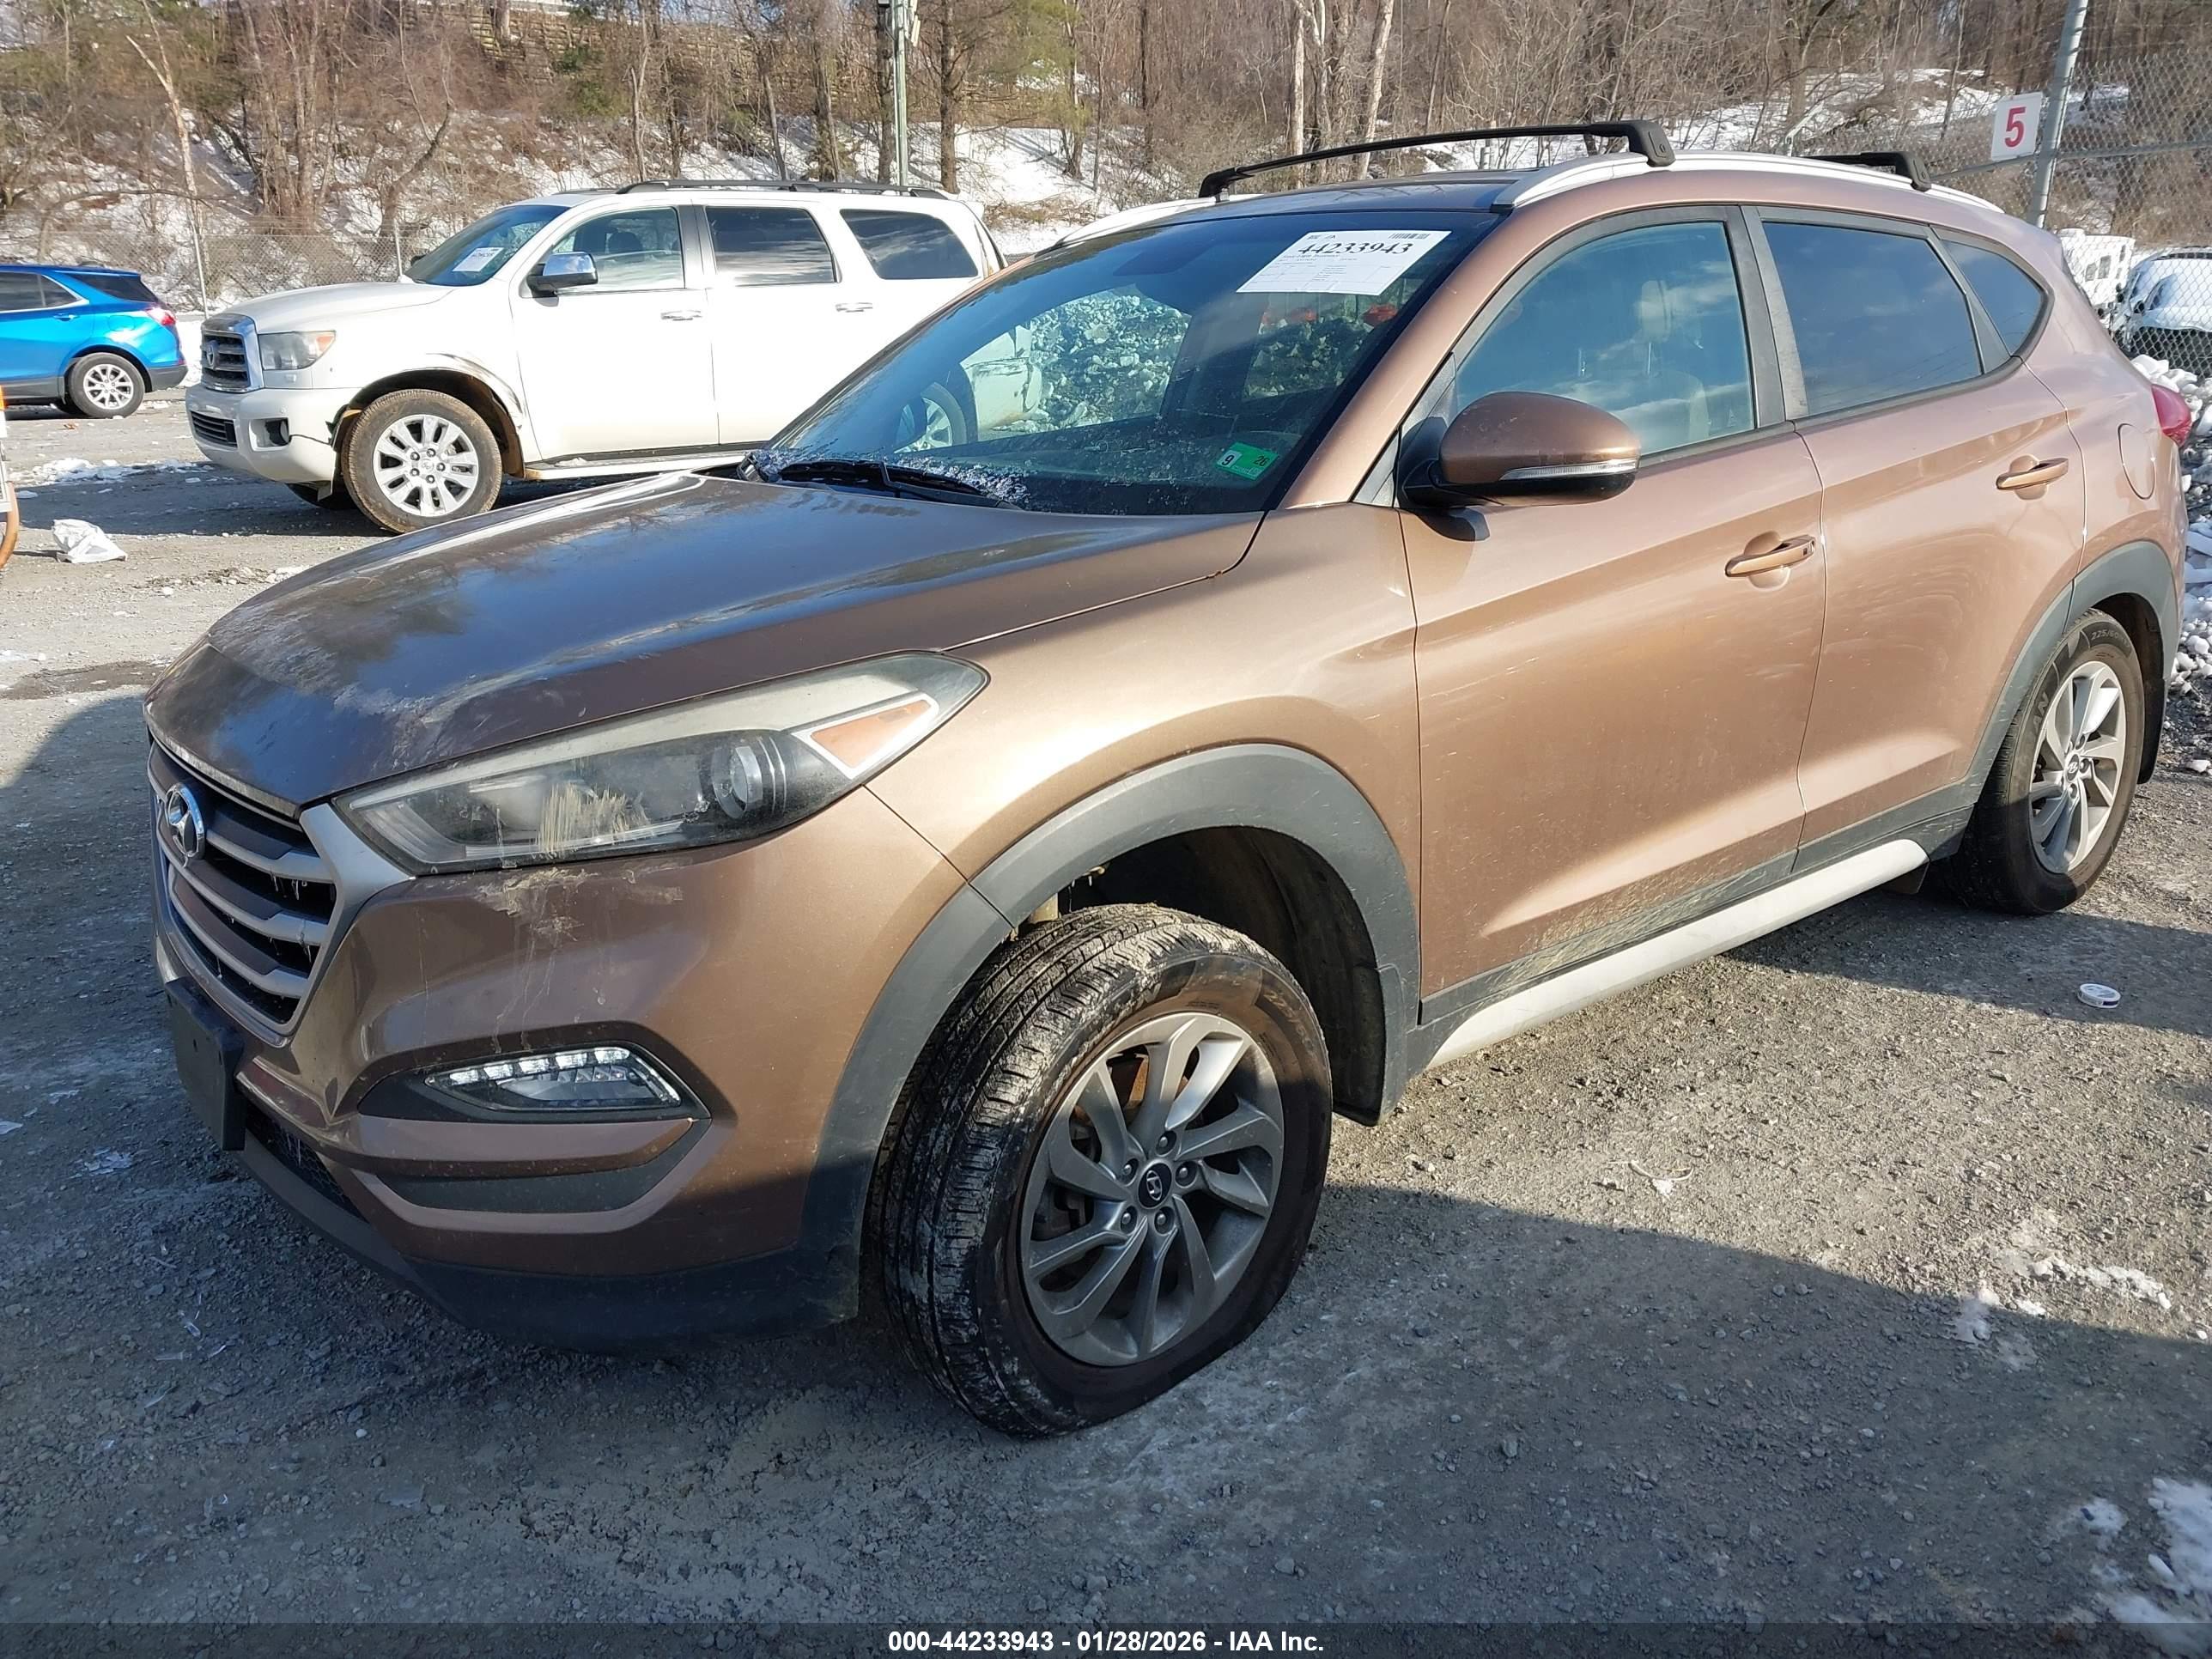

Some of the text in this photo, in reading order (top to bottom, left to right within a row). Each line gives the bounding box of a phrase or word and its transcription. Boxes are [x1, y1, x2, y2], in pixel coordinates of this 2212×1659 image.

[2004, 106, 2027, 148] 5
[1297, 242, 1413, 254] 44233943
[1221, 454, 1234, 465] 9
